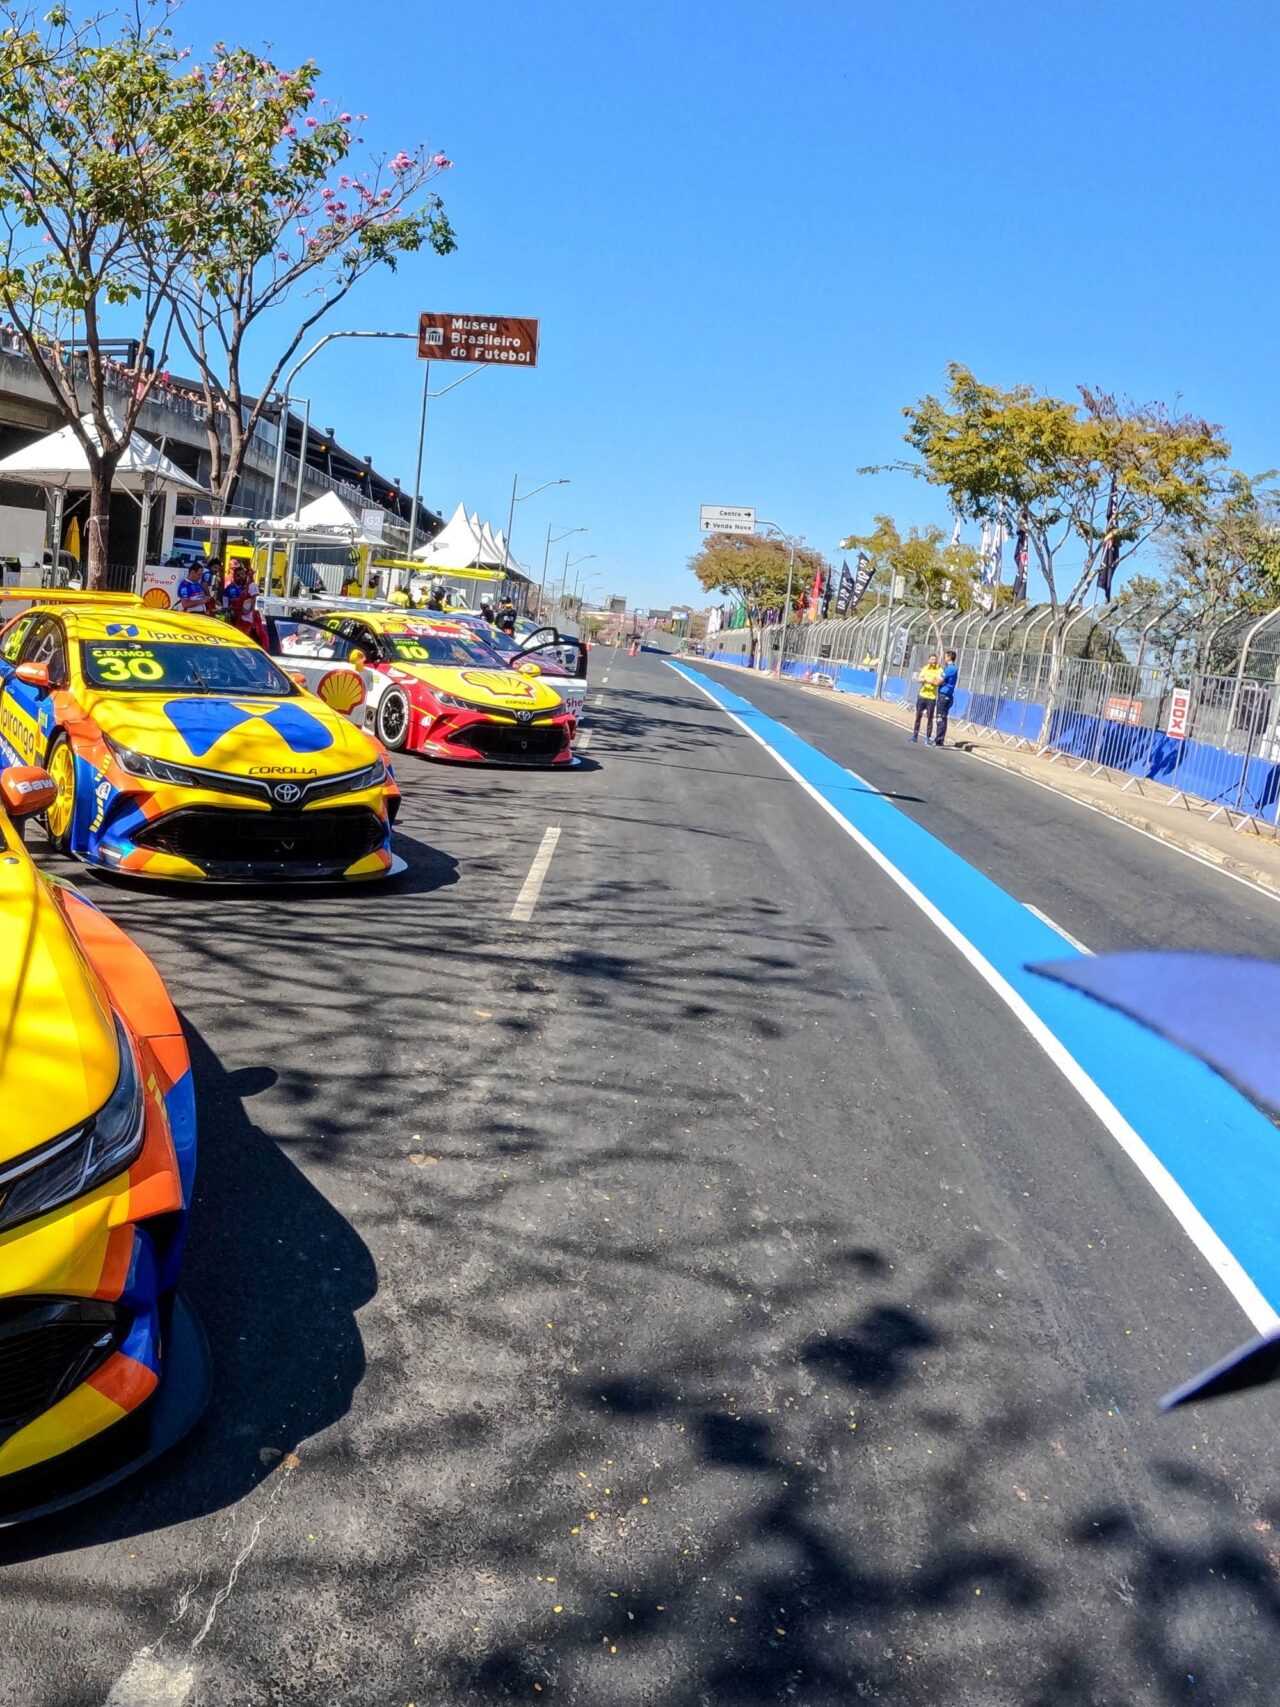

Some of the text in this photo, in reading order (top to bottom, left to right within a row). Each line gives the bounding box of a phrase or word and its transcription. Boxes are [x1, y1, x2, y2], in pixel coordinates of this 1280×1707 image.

[451, 318, 497, 330] Museu
[451, 332, 521, 347] Brasileiro
[450, 346, 530, 362] do Futebol
[367, 516, 380, 526] G2
[734, 523, 752, 531] Nova
[146, 629, 230, 645] Ipiranga
[91, 650, 154, 658] C.RAMOS
[396, 645, 430, 660] 10
[96, 657, 164, 681] 30
[0, 704, 35, 754] Ipiranga
[248, 766, 318, 776] COROLLA
[16, 779, 54, 794] Baw
